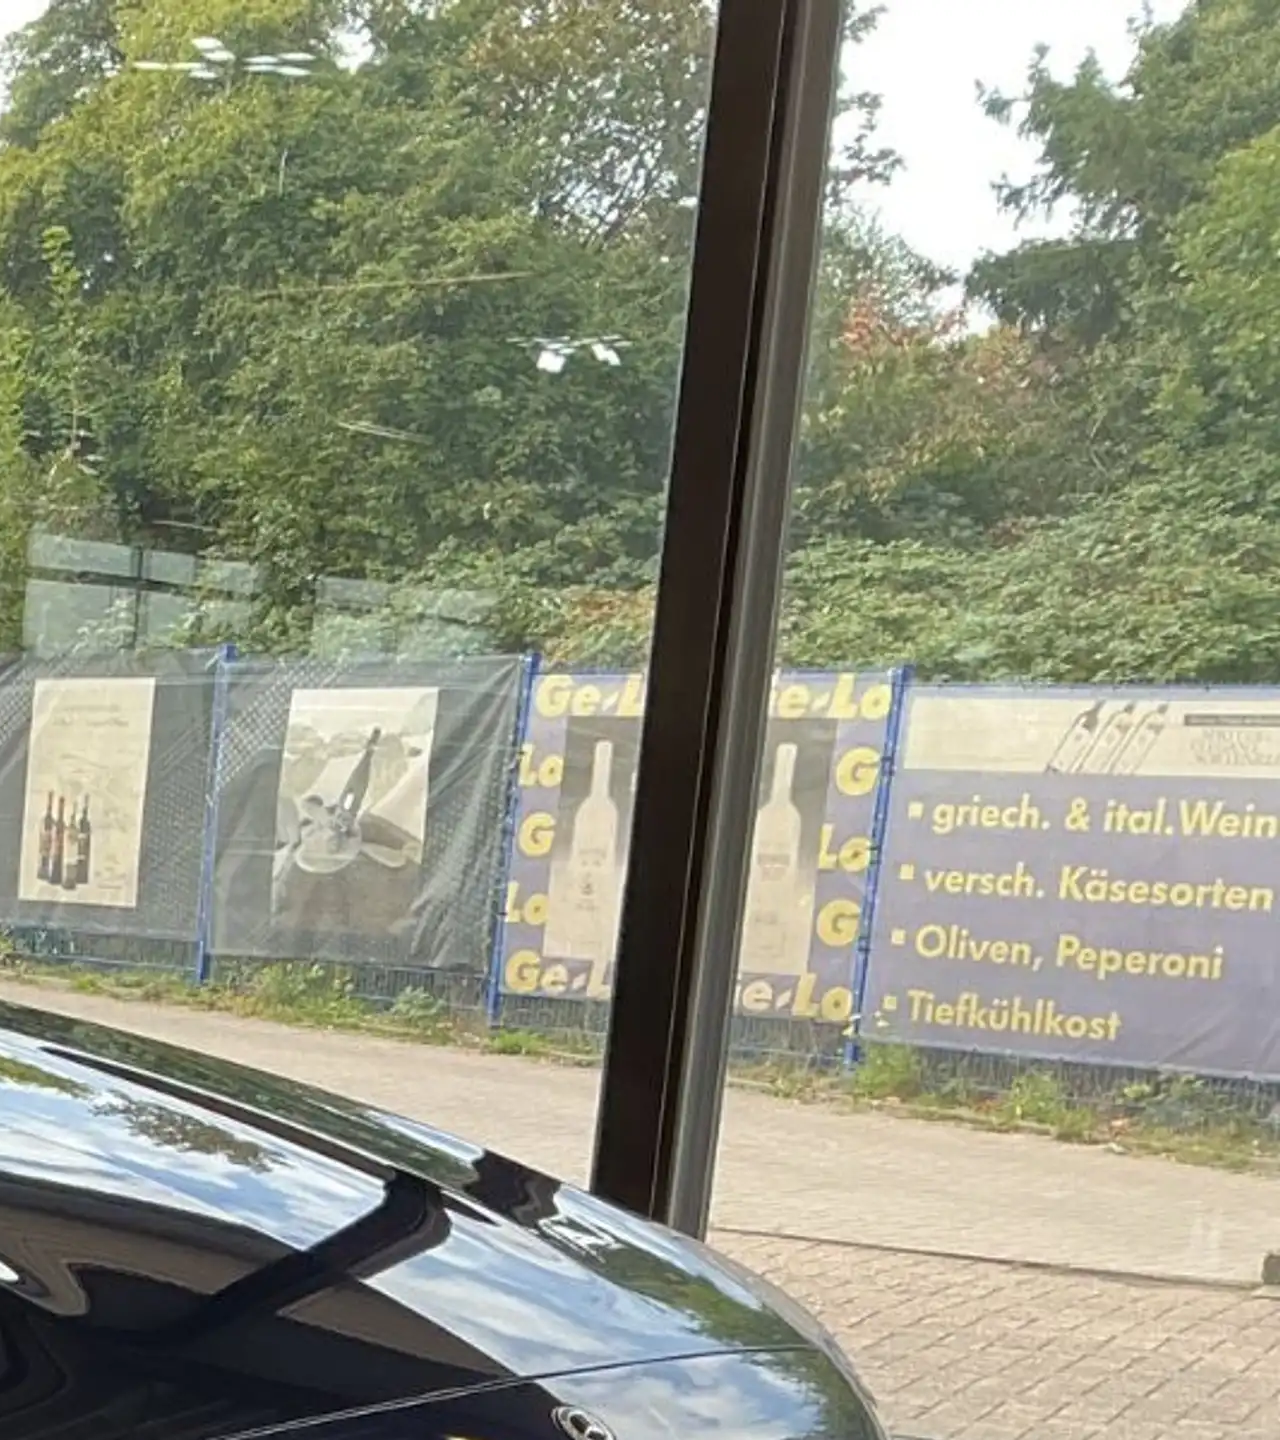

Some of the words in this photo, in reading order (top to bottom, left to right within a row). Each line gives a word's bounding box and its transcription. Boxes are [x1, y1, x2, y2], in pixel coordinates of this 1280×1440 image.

[836, 746, 880, 796] G
[519, 812, 557, 856] G
[932, 793, 1051, 834] griech.
[1064, 797, 1091, 832] &
[818, 822, 872, 872] Lo
[504, 881, 550, 926] Lo
[924, 861, 1045, 899] versch.
[1058, 865, 1274, 913] Käsesorten
[816, 899, 861, 946] G
[915, 923, 1043, 972] Oliven,
[1055, 934, 1224, 981] Peperoni
[907, 989, 1122, 1042] Tiefkühlkost
